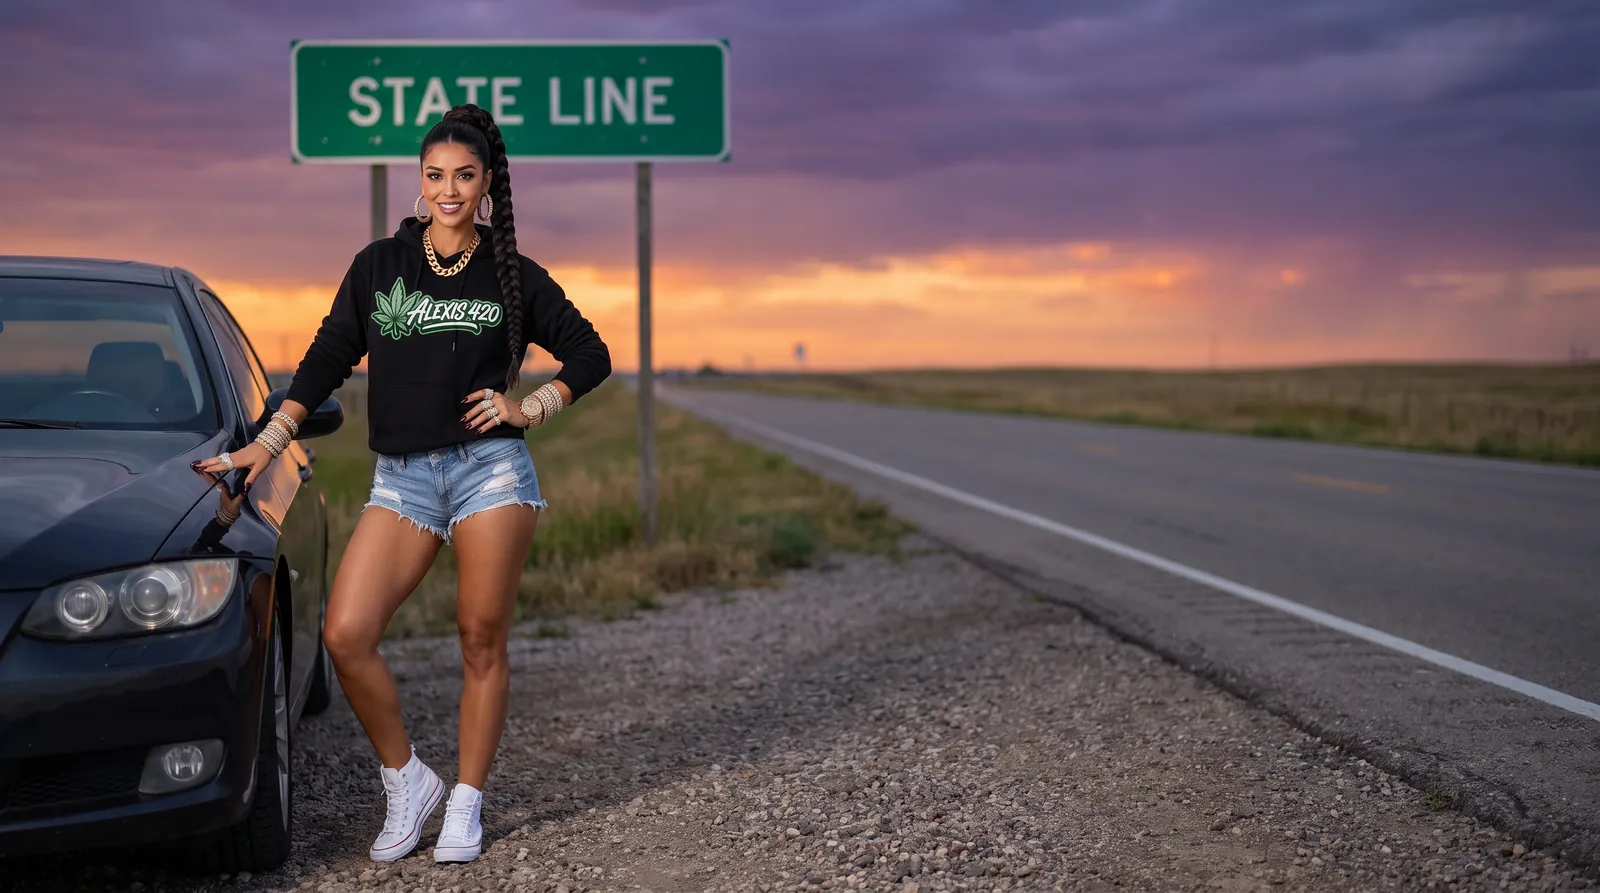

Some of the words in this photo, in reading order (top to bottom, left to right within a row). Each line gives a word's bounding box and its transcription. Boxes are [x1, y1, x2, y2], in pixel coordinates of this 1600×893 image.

[348, 76, 524, 127] STATE
[549, 76, 675, 126] LINE
[406, 297, 468, 326] ALEXIS
[467, 301, 500, 323] 420
